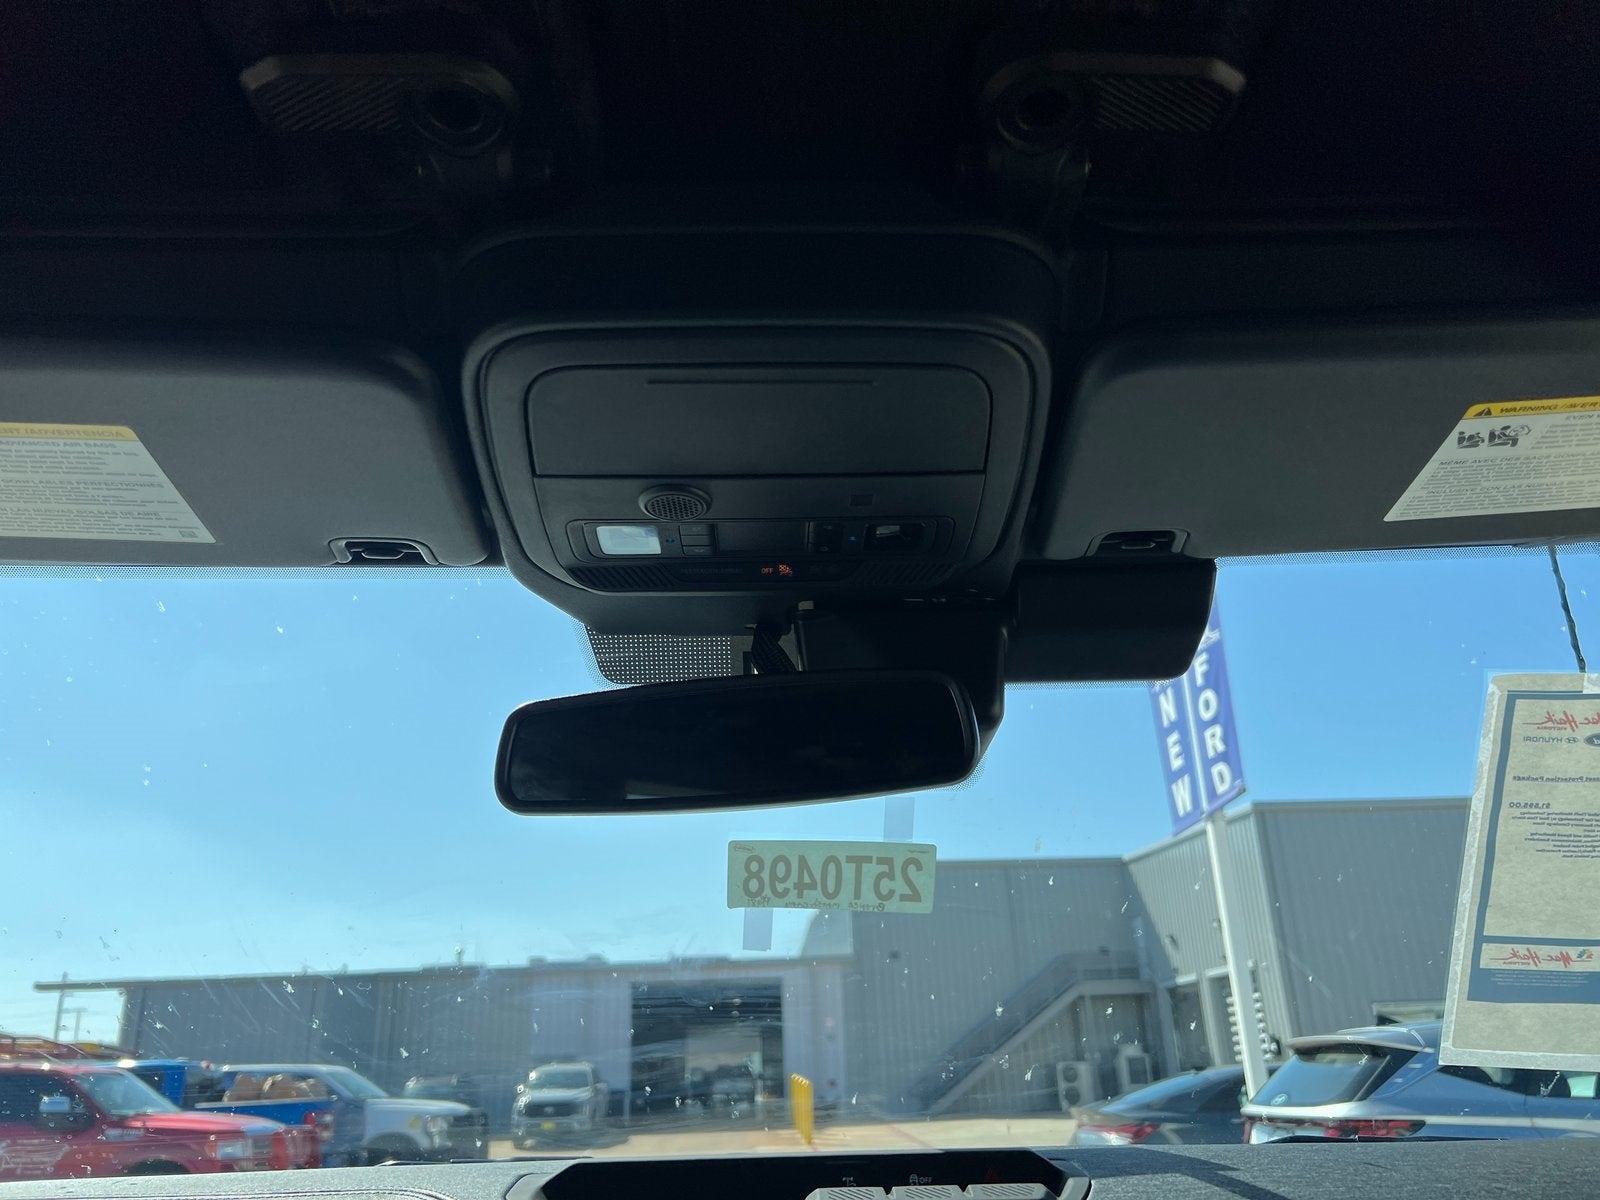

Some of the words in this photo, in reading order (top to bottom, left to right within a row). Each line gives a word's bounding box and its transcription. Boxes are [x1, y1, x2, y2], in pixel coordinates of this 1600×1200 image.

[1499, 404, 1558, 413] WARNING
[1159, 685, 1193, 818] NEW
[1194, 653, 1233, 796] FORD
[919, 1176, 933, 1184] OFF
